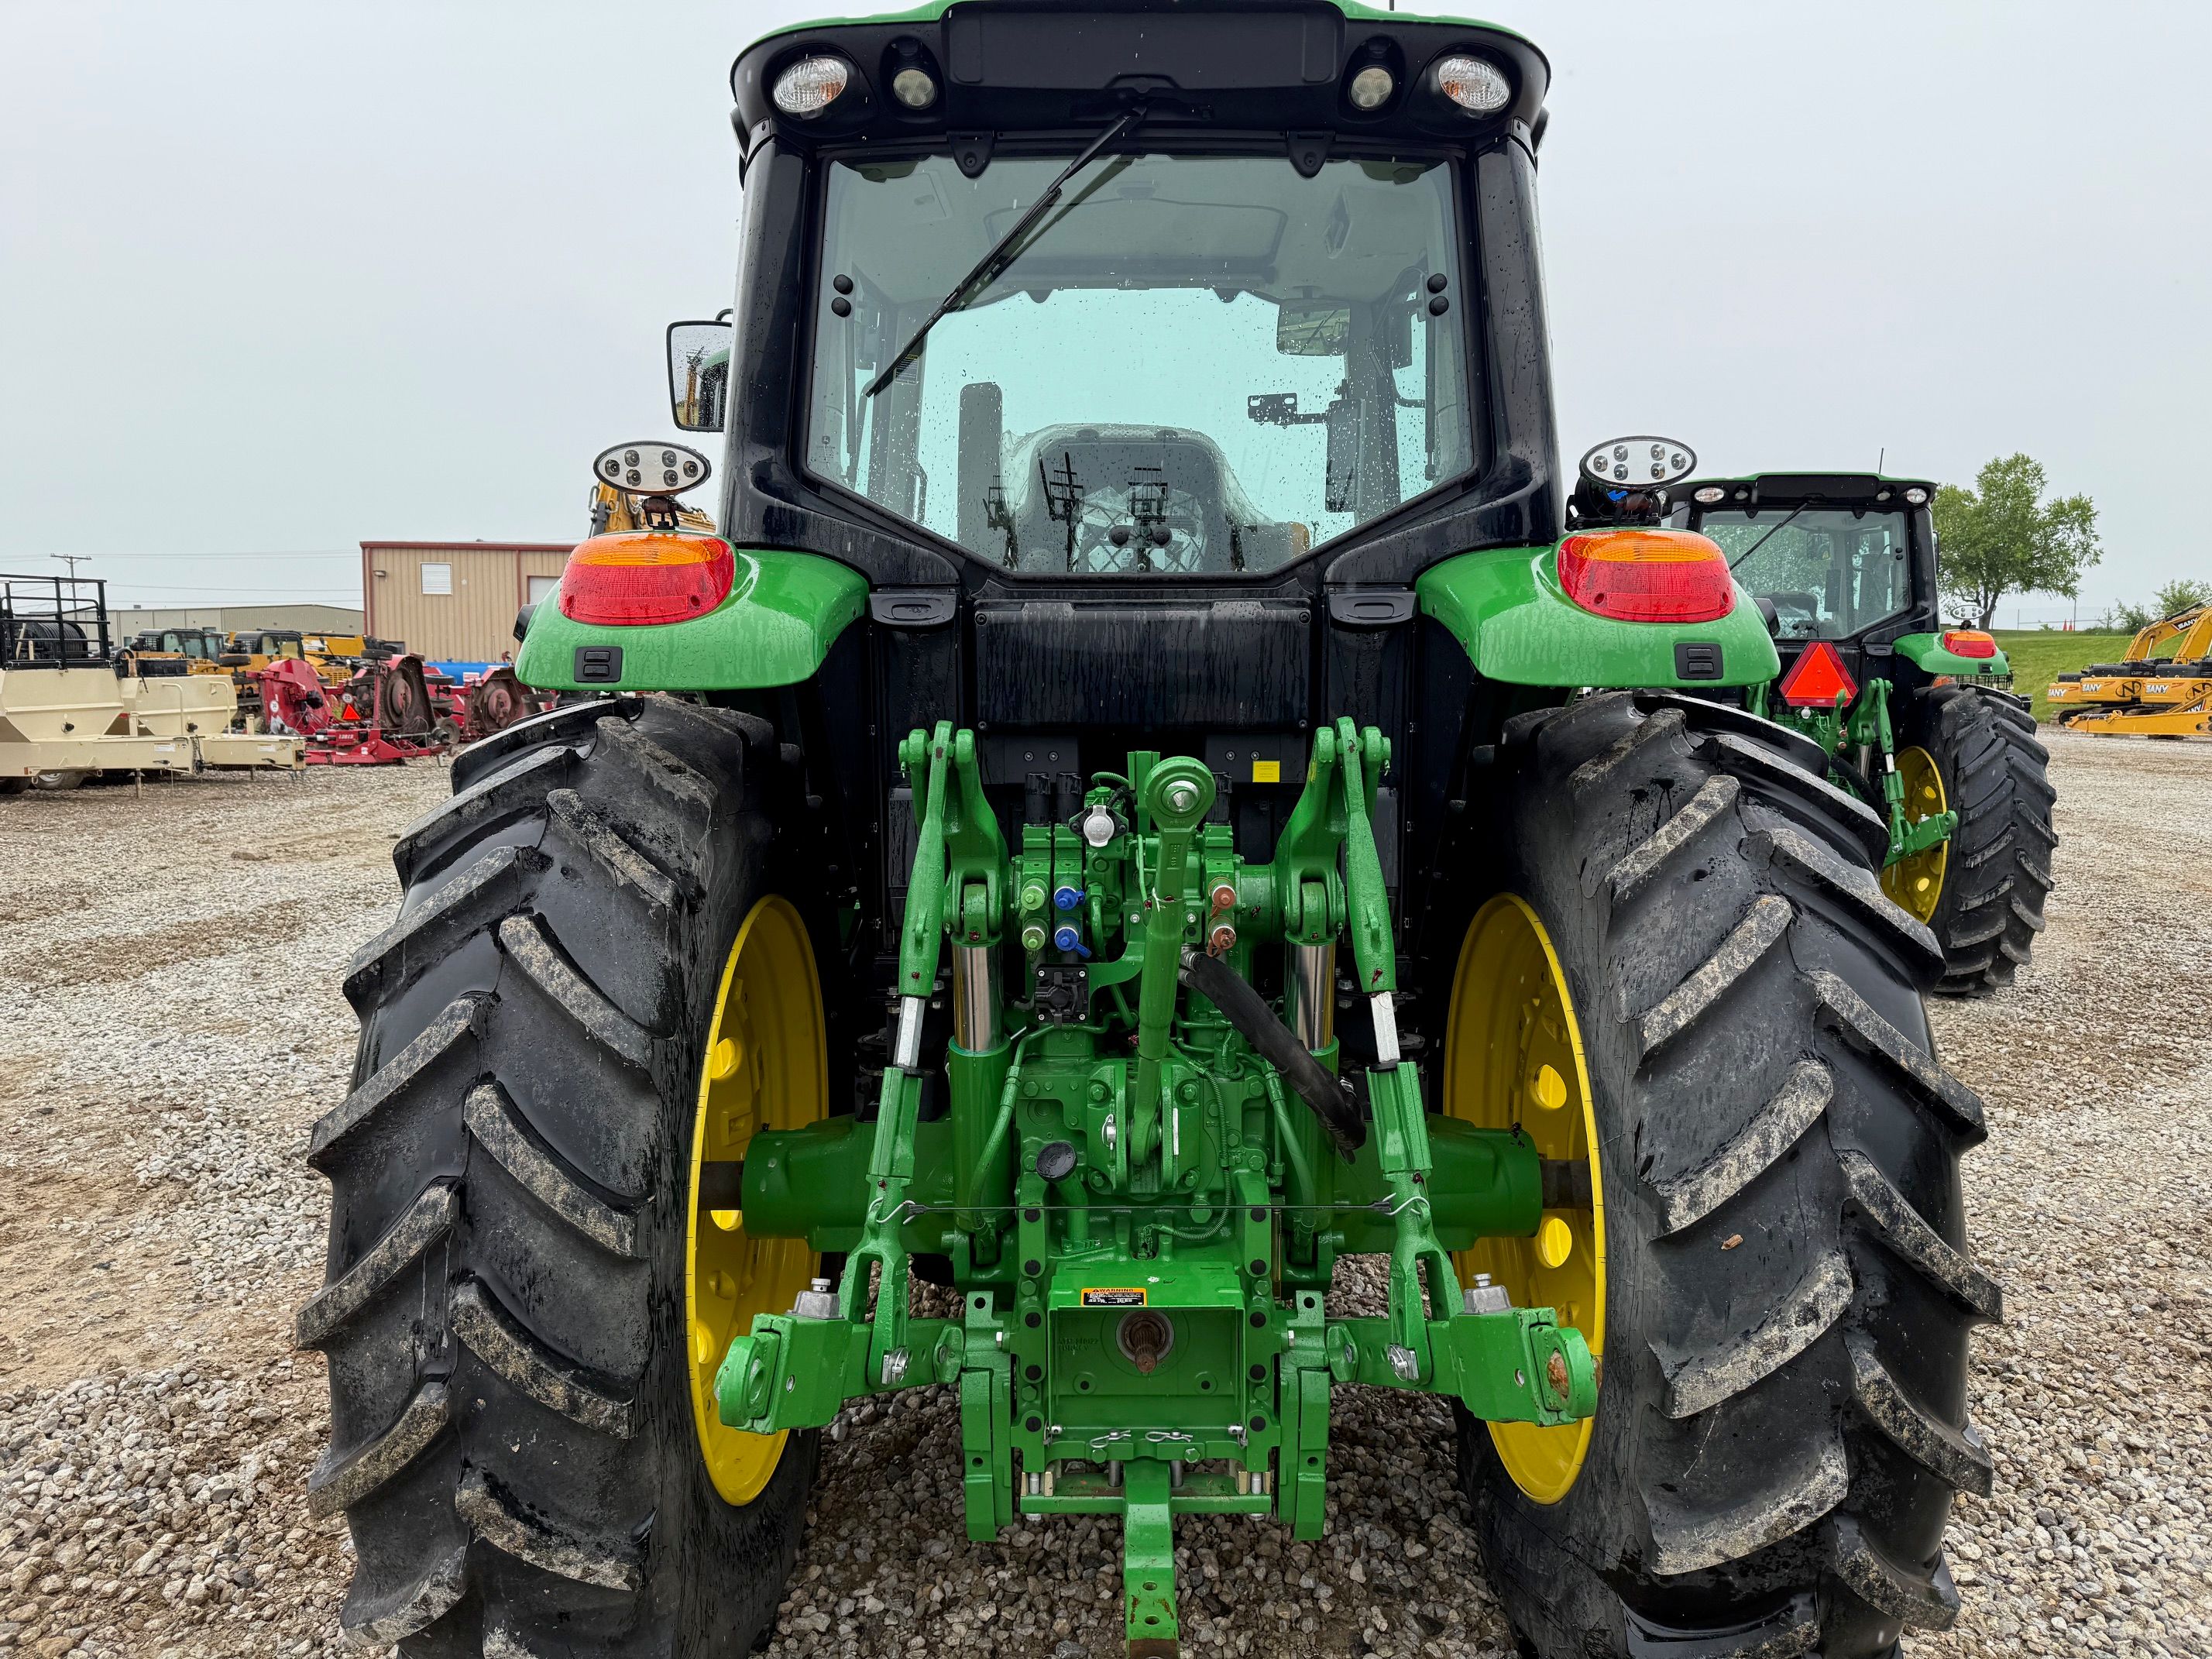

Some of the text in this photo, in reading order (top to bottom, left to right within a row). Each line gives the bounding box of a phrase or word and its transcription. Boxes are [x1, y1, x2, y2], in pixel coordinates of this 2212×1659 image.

[2178, 617, 2197, 630] SANY
[2082, 683, 2101, 692] SANY
[2145, 685, 2169, 694] SANY
